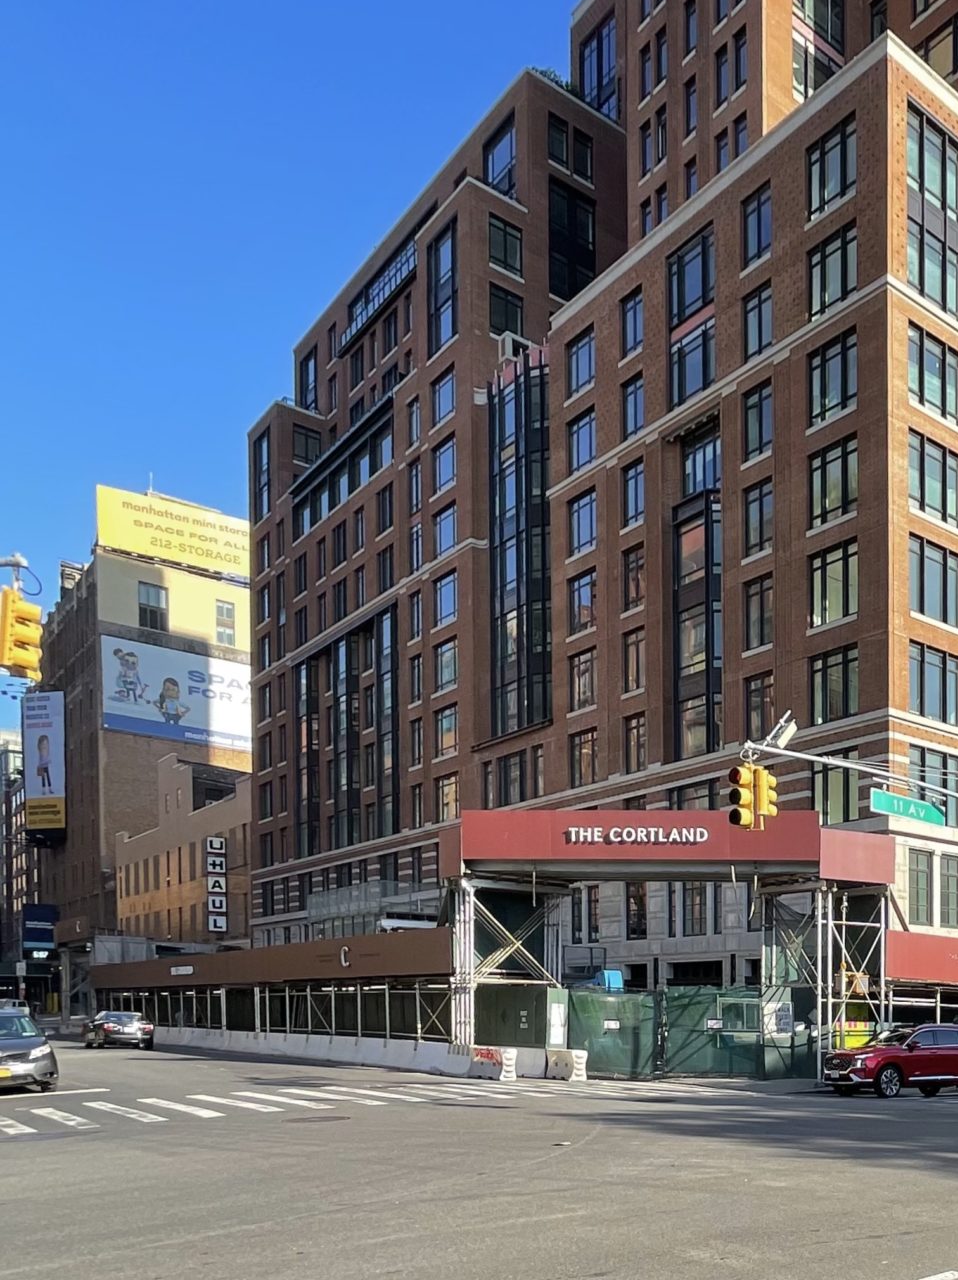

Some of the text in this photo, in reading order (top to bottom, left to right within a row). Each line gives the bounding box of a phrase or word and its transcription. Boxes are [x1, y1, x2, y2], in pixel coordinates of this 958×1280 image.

[122, 501, 189, 523] manhattan
[192, 519, 216, 530] mini
[133, 519, 185, 538] SPACE
[189, 532, 218, 545] FOR
[150, 536, 241, 565] 212-STORAGE
[188, 686, 233, 702] FOR
[893, 799, 904, 813] 11
[568, 827, 709, 842] THE CORTLAND
